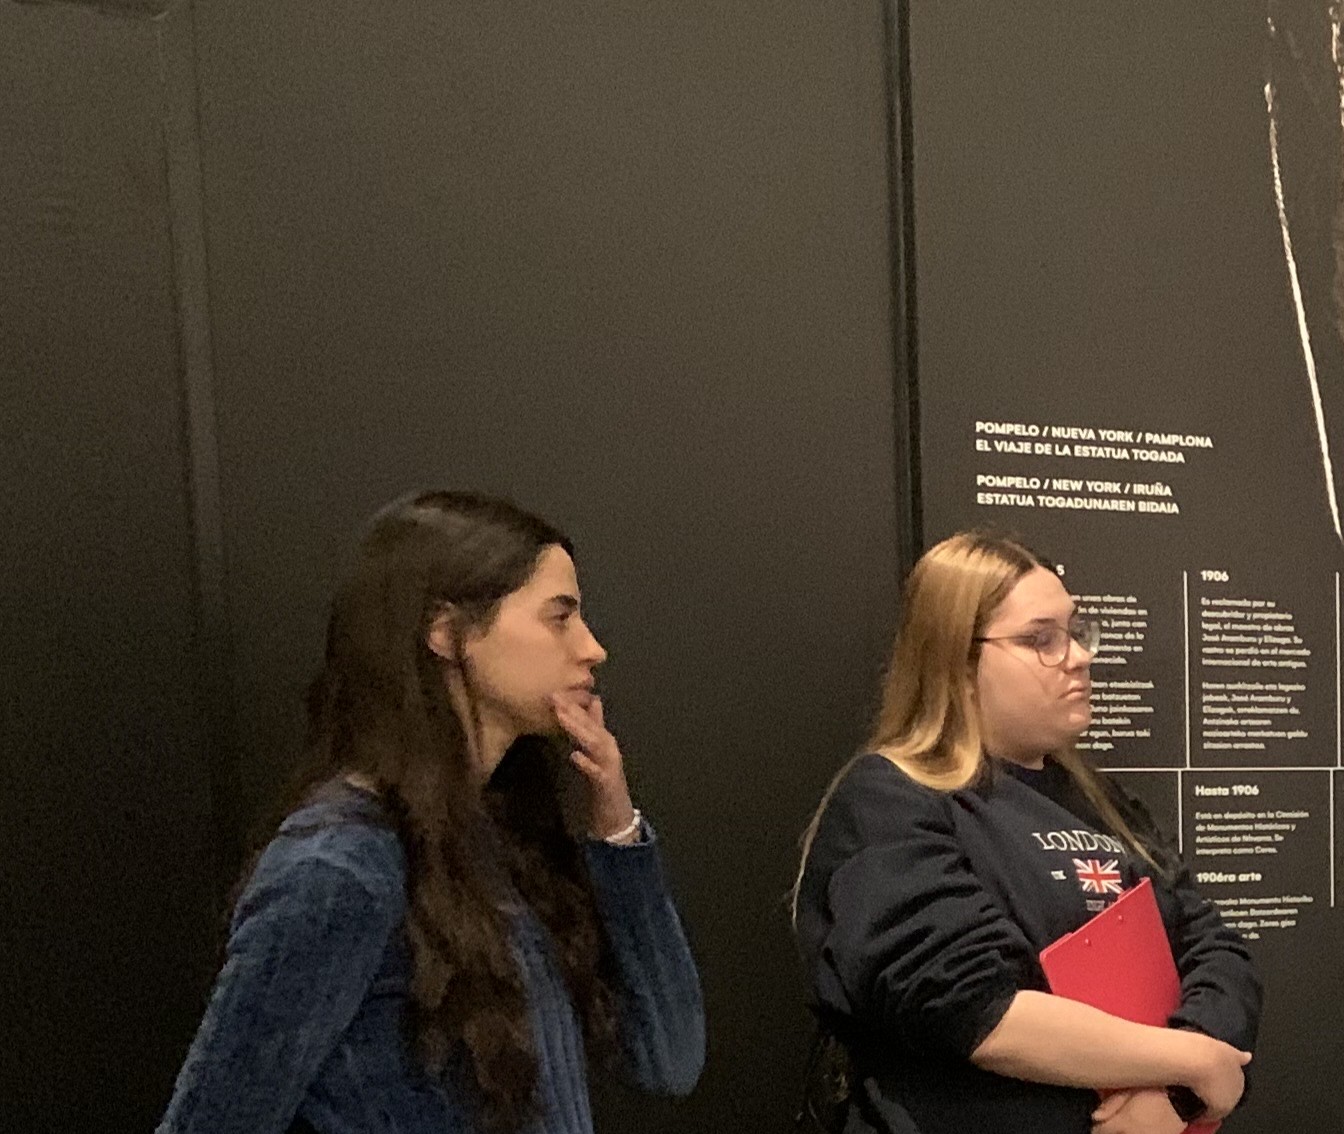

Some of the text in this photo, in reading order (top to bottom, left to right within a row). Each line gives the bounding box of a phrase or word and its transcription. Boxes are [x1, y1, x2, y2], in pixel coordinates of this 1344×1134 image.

[976, 422, 1039, 436] POMPELO
[1052, 426, 1096, 440] NUEVA
[1098, 430, 1133, 442] YORK
[1145, 433, 1213, 448] PAMPLONA
[976, 439, 1185, 463] EL VIAJE DE LA ESTATUA TOGADA
[977, 475, 1040, 489] POMPELO
[1052, 479, 1083, 491] NEW
[1086, 481, 1121, 493] YORK
[1133, 482, 1172, 496] IRUÑA
[977, 493, 1179, 514] ESTATUA TOGADUNAREN BIDAIA
[1201, 570, 1229, 582] 1906
[1195, 785, 1259, 796] Hasta 1906
[1196, 872, 1262, 882] 1906ra arte
